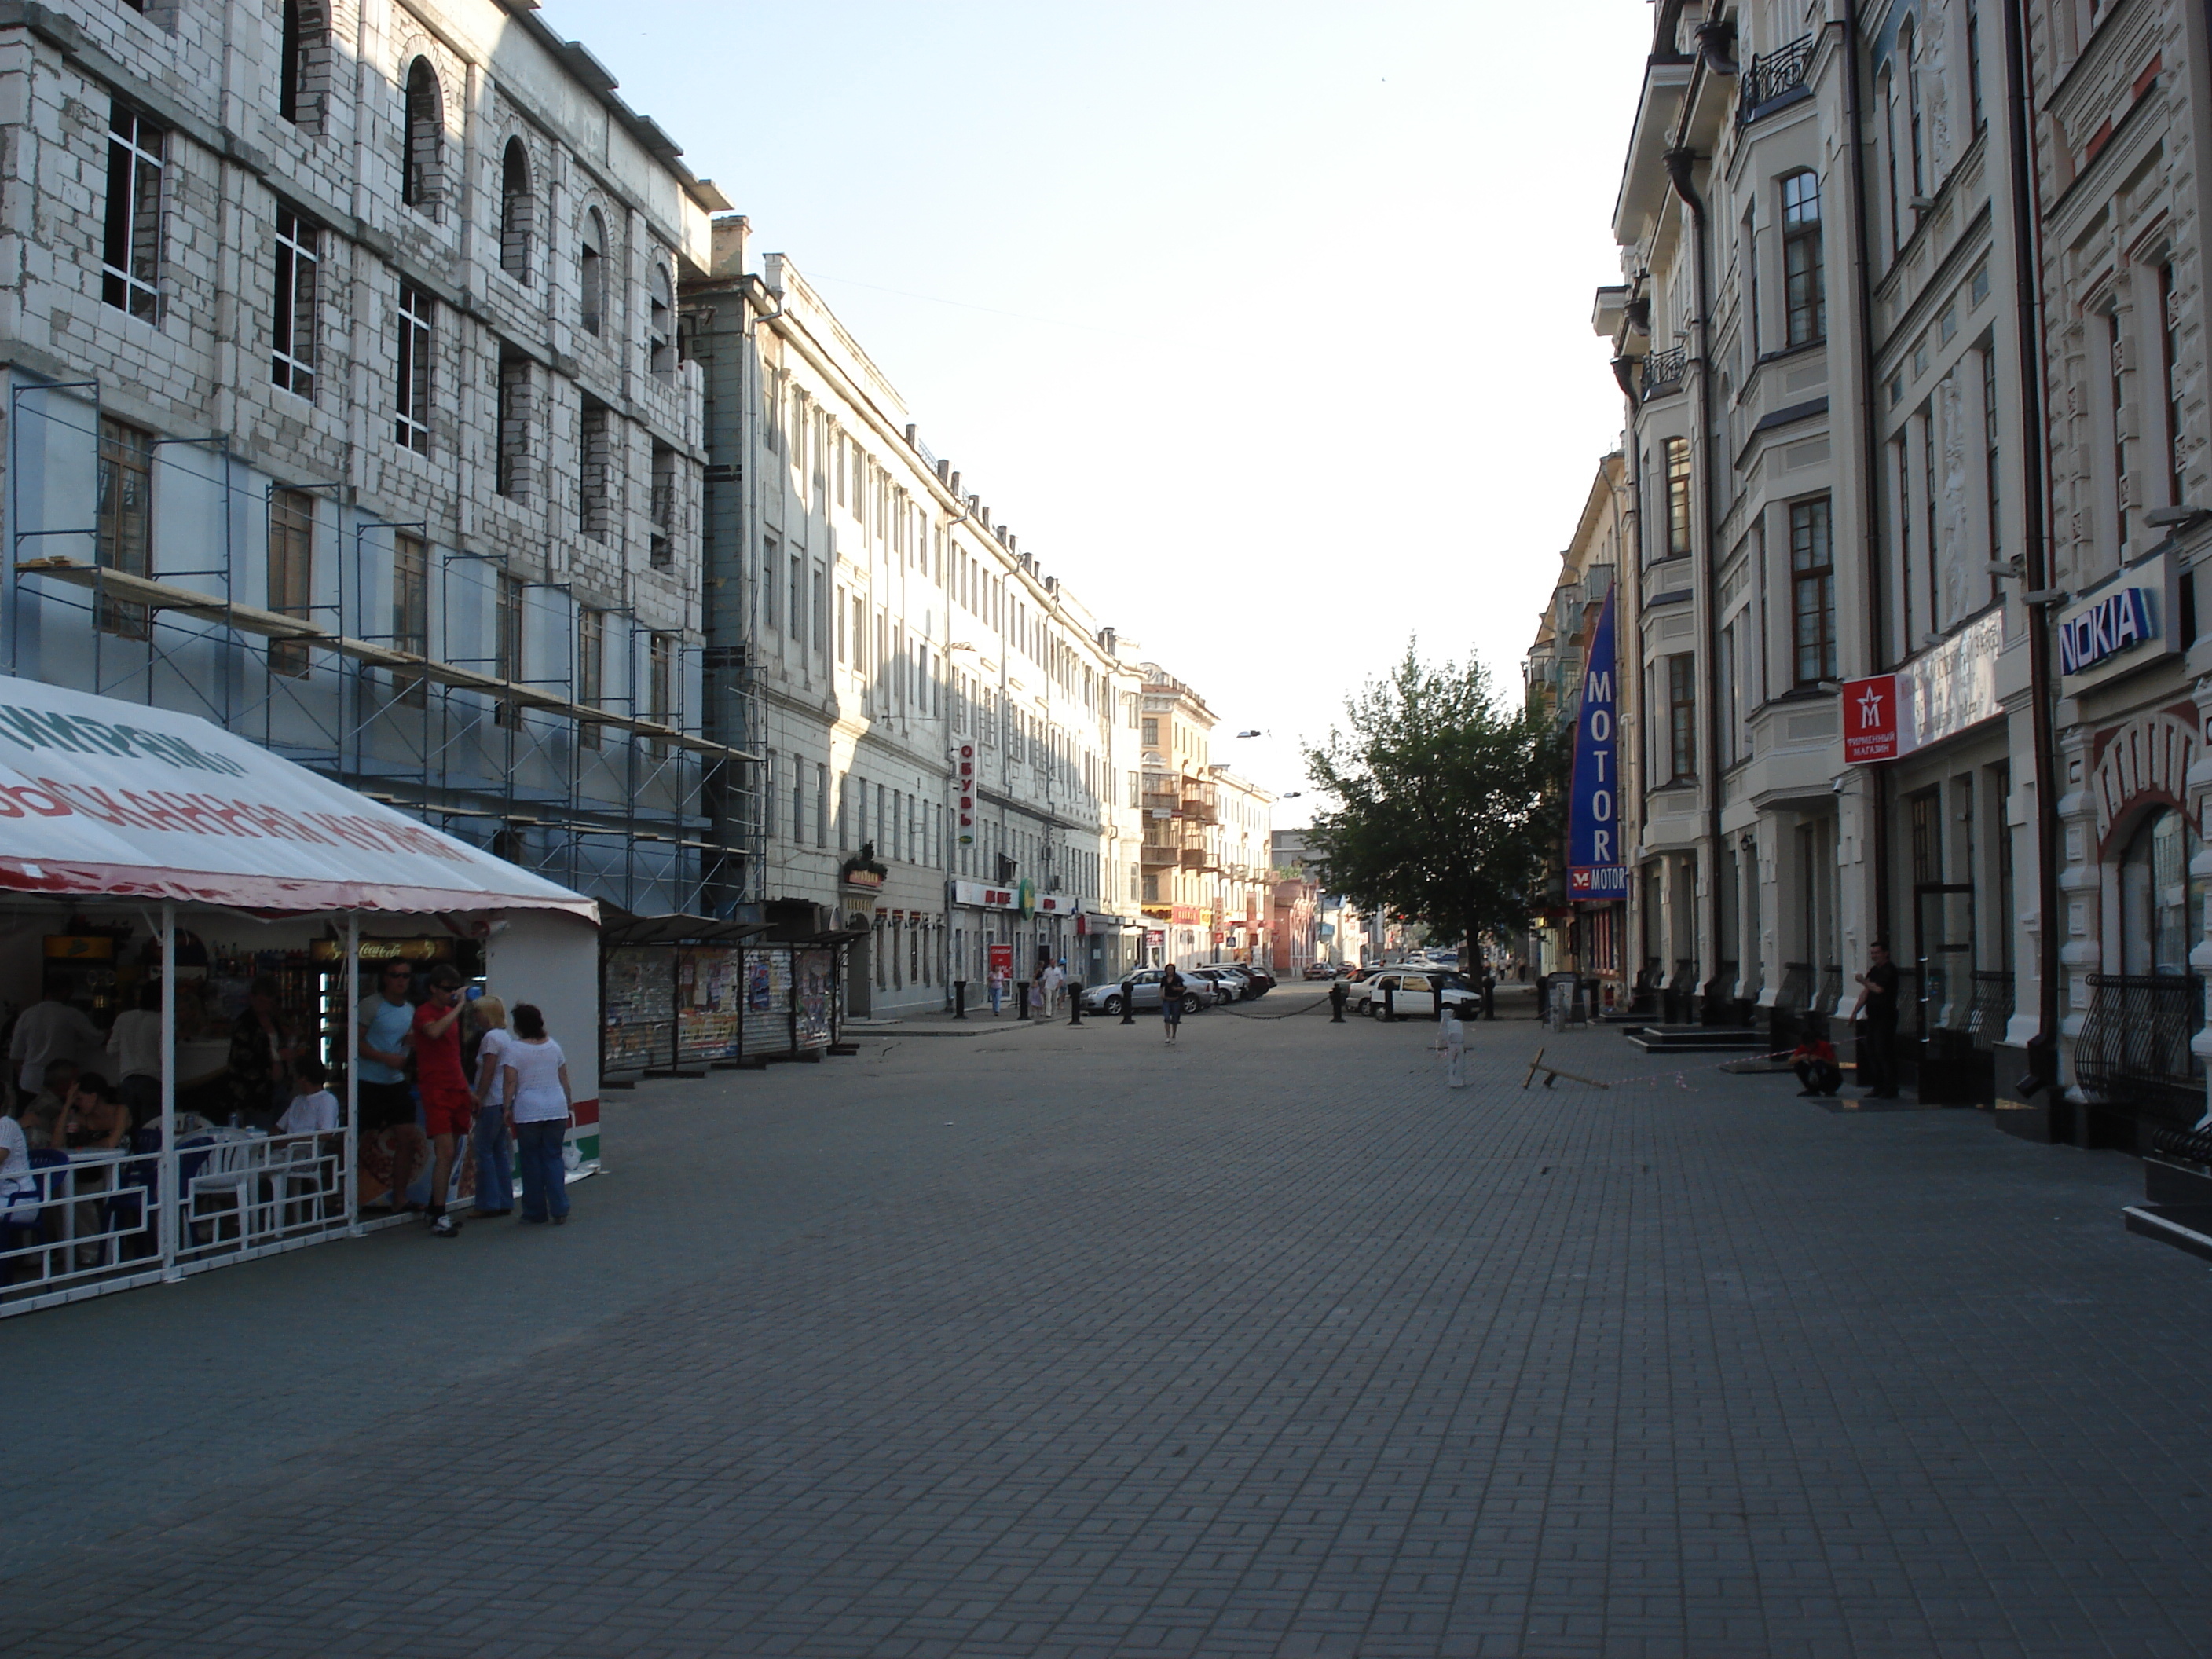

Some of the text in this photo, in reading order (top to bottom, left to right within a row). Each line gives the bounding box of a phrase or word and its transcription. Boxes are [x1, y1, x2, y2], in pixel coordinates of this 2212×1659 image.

[2058, 588, 2152, 676] NOKIA
[1588, 670, 1612, 862] MOTOR
[1846, 731, 1895, 747] ФИРМЕННЫЙ
[1853, 743, 1890, 756] МАГАЗИН
[960, 745, 973, 827] ОБУВЬ
[300, 810, 474, 864] КУХНЯ
